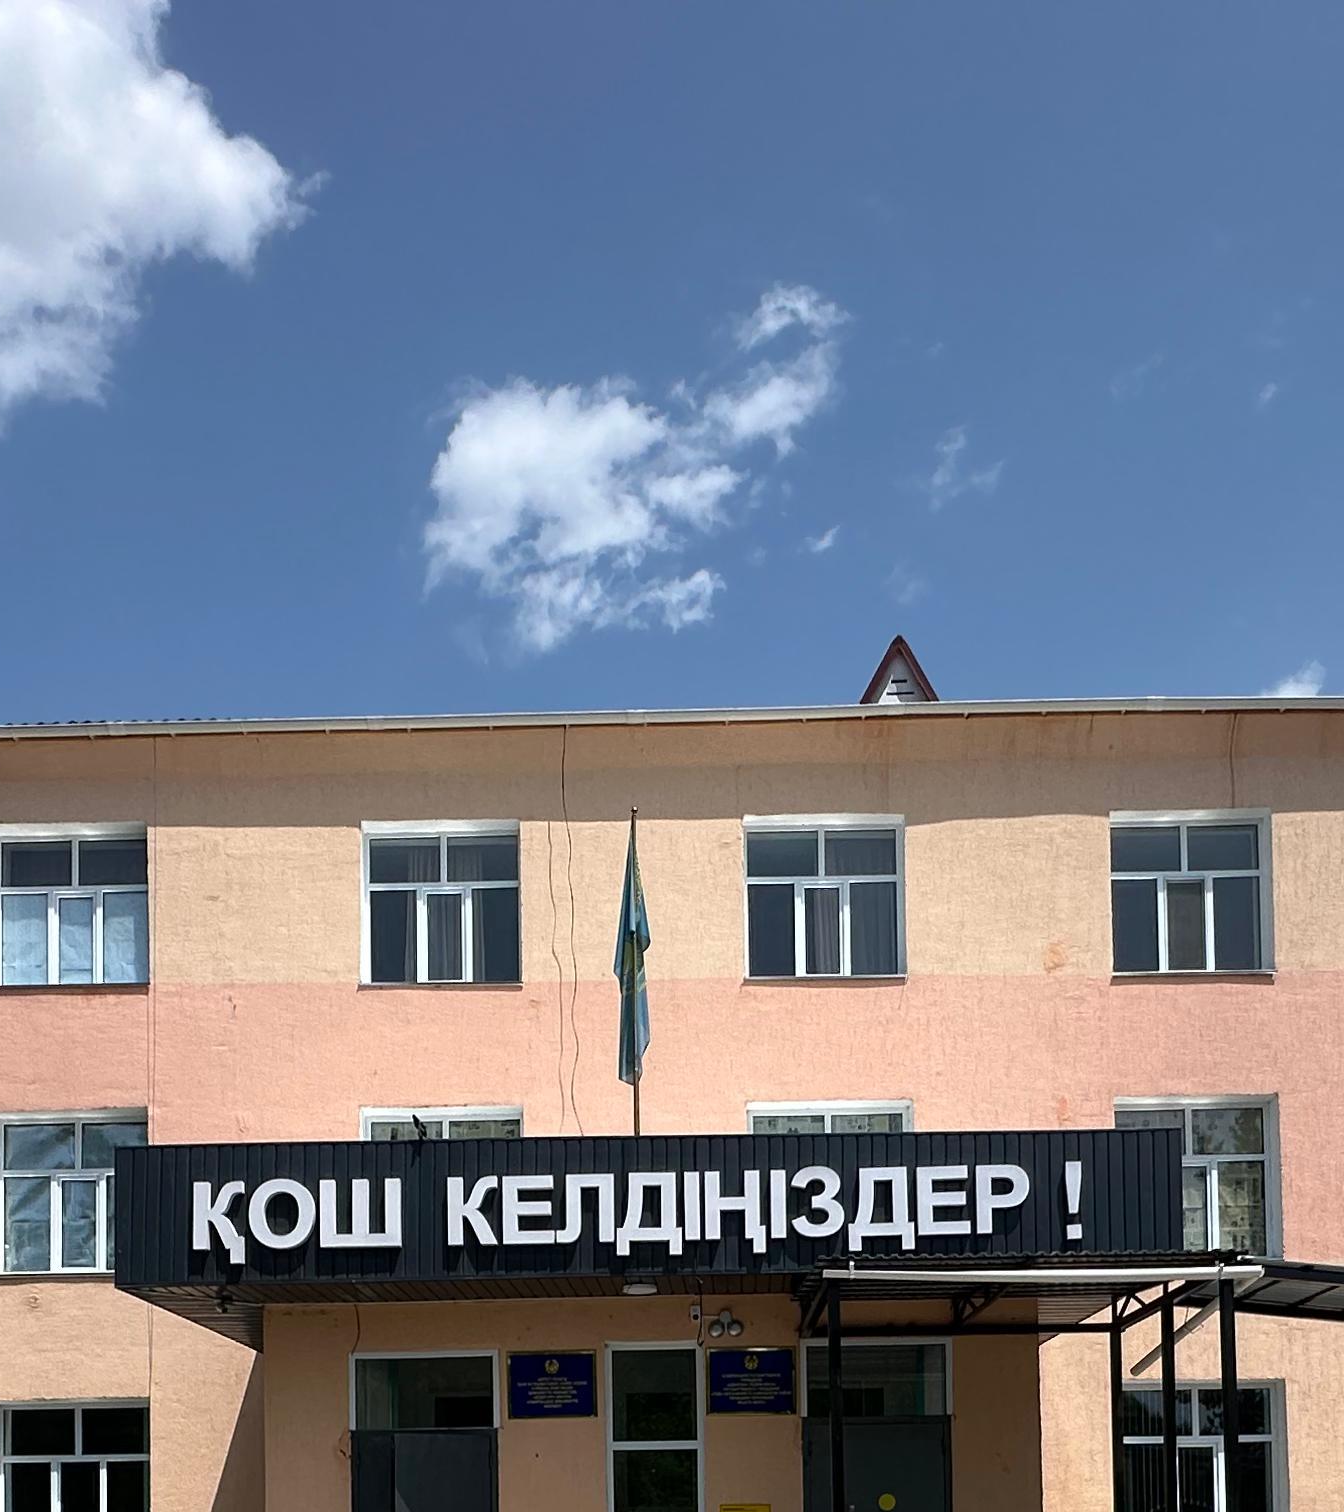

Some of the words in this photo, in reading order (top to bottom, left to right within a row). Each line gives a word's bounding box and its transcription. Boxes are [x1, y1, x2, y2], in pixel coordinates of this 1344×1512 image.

[192, 1179, 402, 1264] ҚОШ
[447, 1164, 1030, 1255] КЕЛДІҢІЗДЕР
[1065, 1161, 1083, 1240] !
